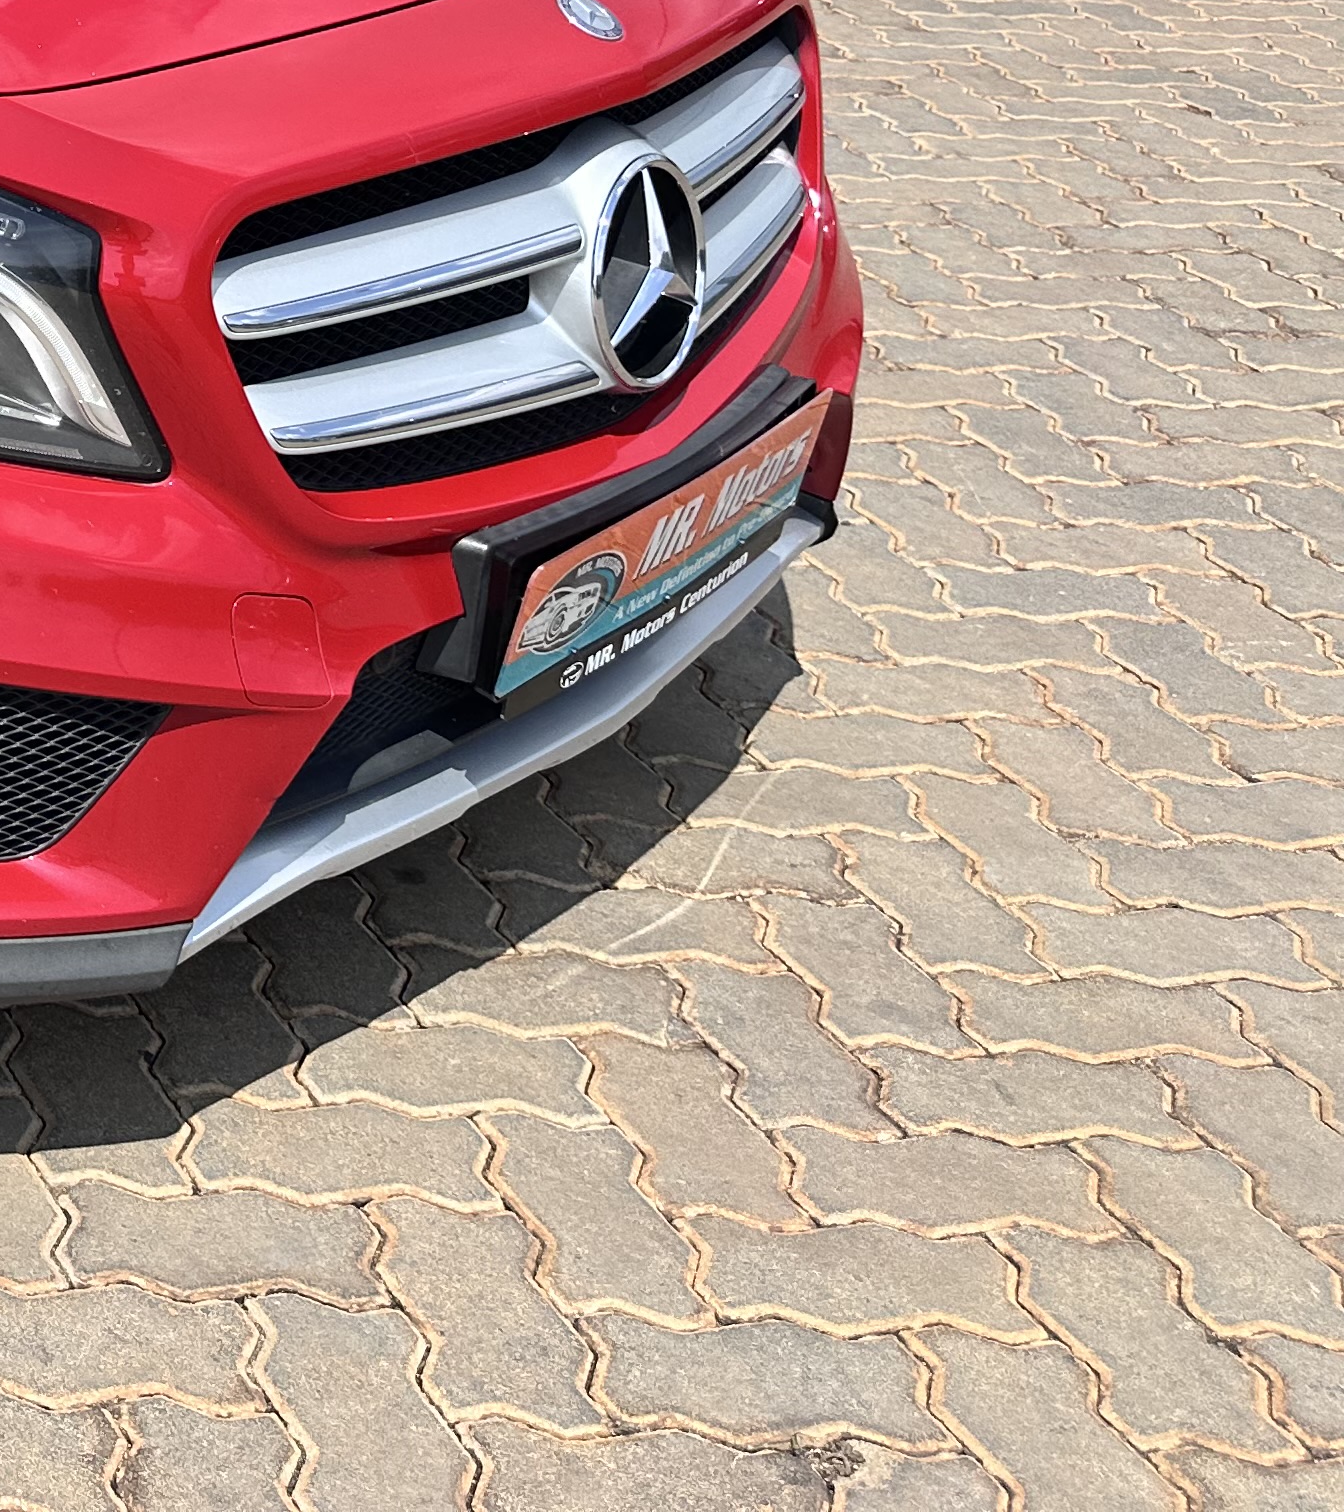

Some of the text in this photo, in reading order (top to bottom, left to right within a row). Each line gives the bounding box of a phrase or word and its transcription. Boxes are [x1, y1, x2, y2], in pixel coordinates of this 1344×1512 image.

[632, 428, 812, 581] MR. Motors
[584, 552, 748, 676] MR. Motors Centurion
[612, 606, 623, 623] A
[627, 588, 658, 615] New
[659, 544, 721, 594] Definition
[721, 533, 736, 549] to
